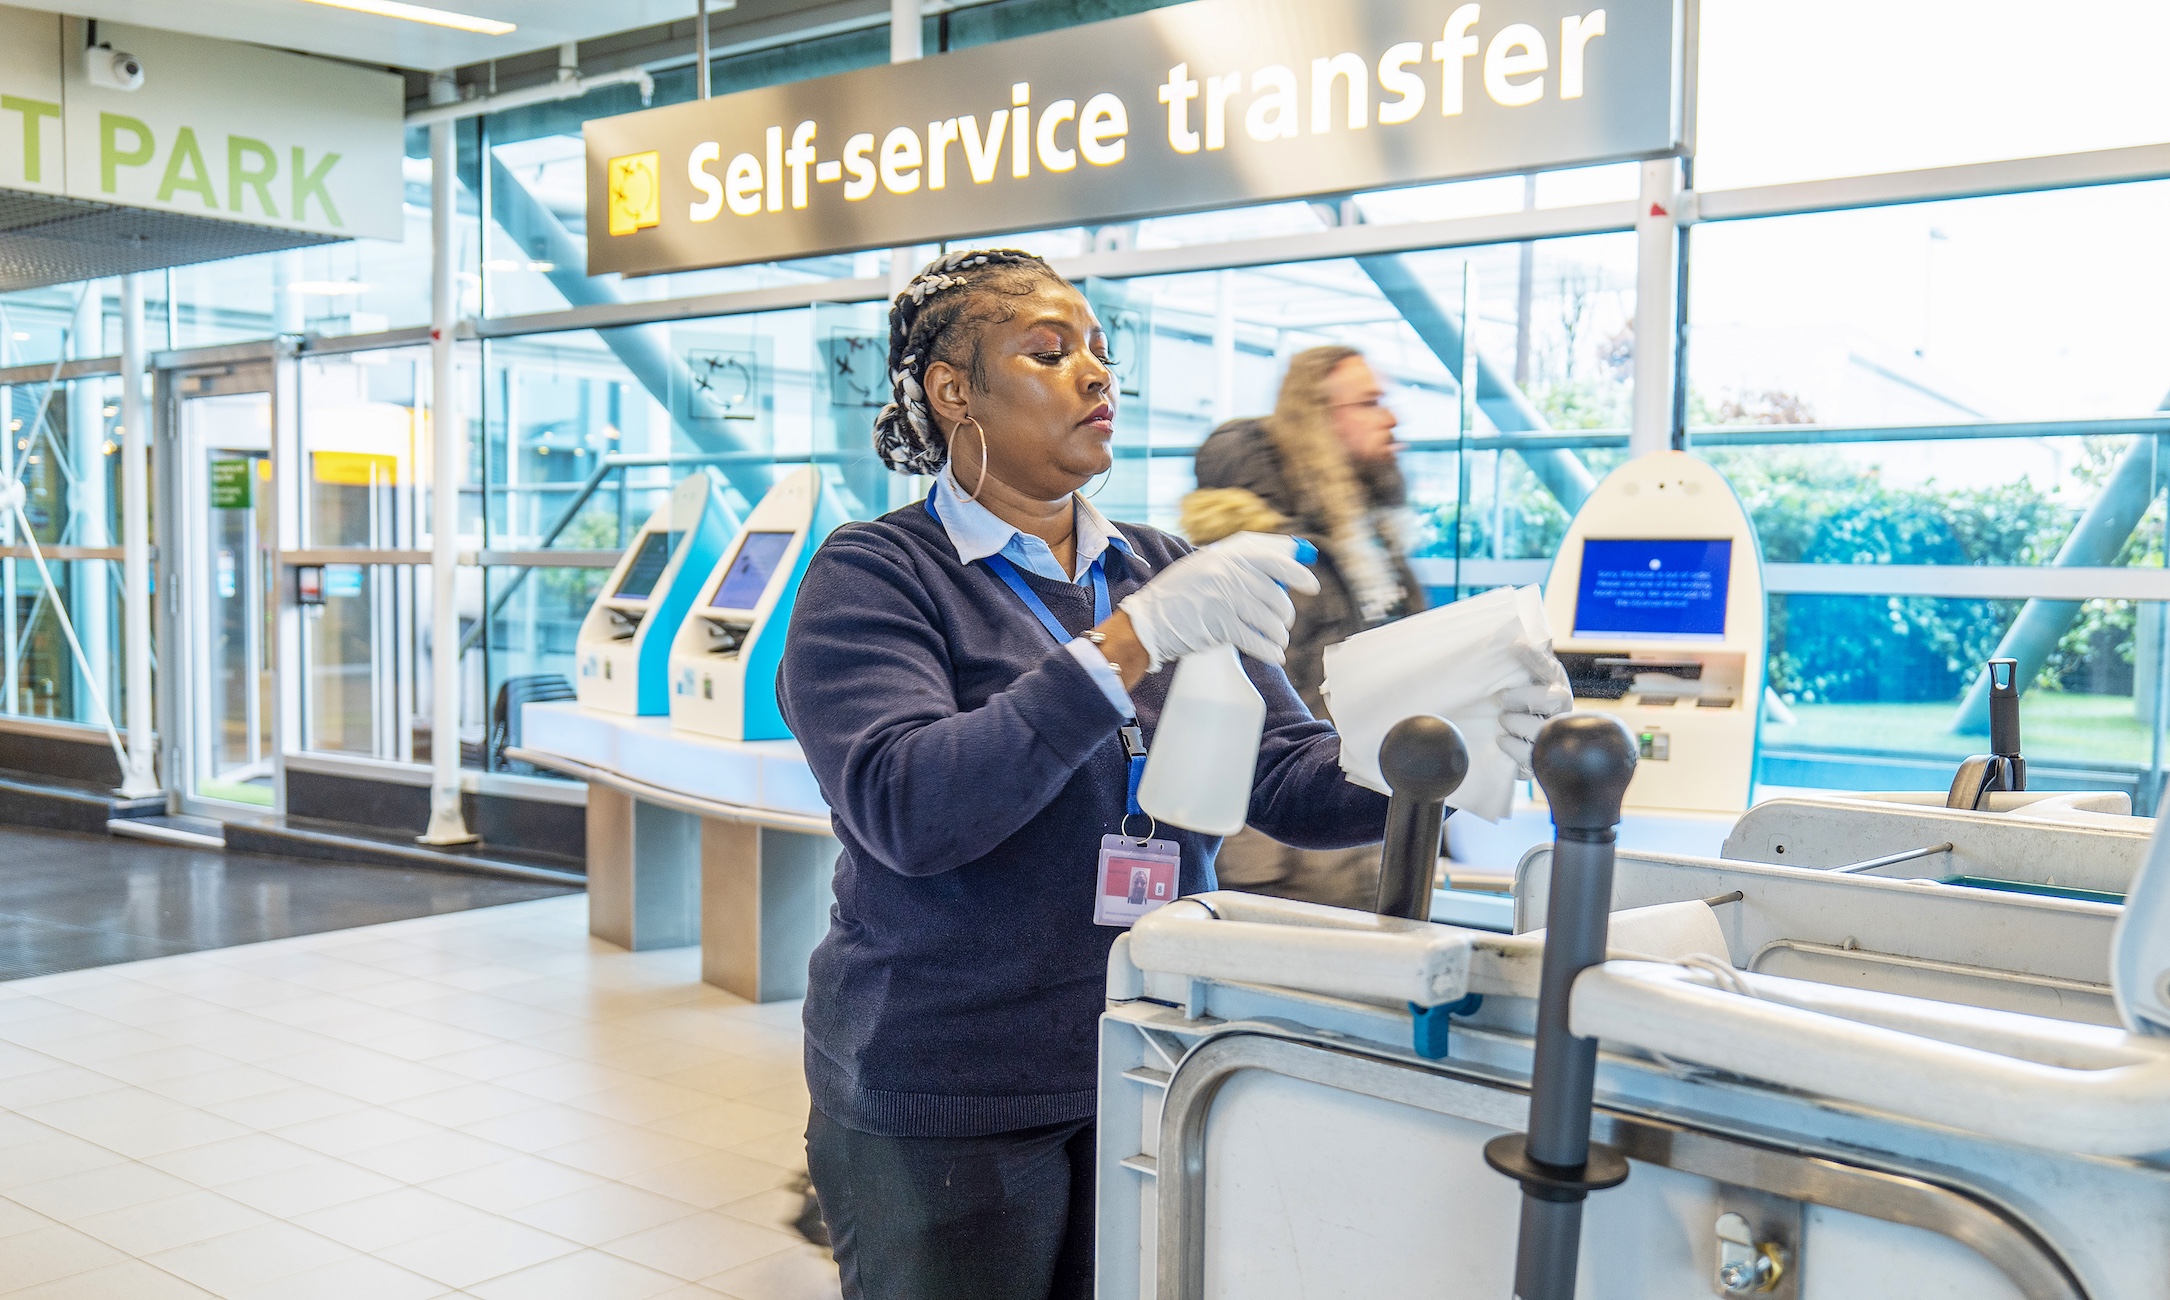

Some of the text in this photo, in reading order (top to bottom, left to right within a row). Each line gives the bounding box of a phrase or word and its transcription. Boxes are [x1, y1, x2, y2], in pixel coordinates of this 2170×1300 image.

[100, 111, 345, 228] PARK
[688, 2, 1607, 223] Self-service transfer
